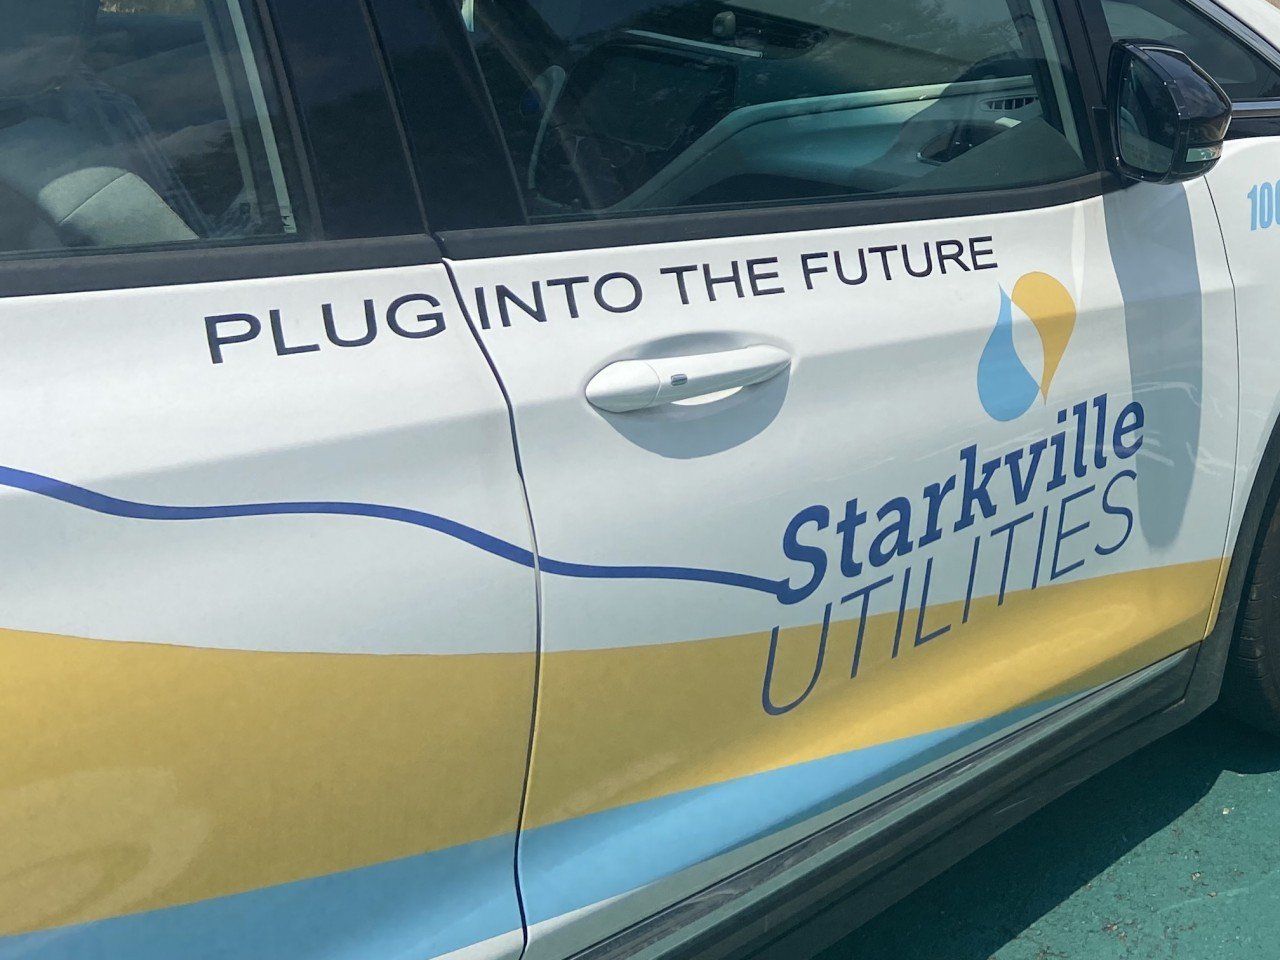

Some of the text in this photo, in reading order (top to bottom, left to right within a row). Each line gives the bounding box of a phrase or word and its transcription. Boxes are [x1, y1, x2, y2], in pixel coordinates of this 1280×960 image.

[205, 235, 998, 364] PLUG INTO THE FUTURE
[761, 470, 1138, 716] UTILITIES
[776, 393, 1145, 605] Starkville
